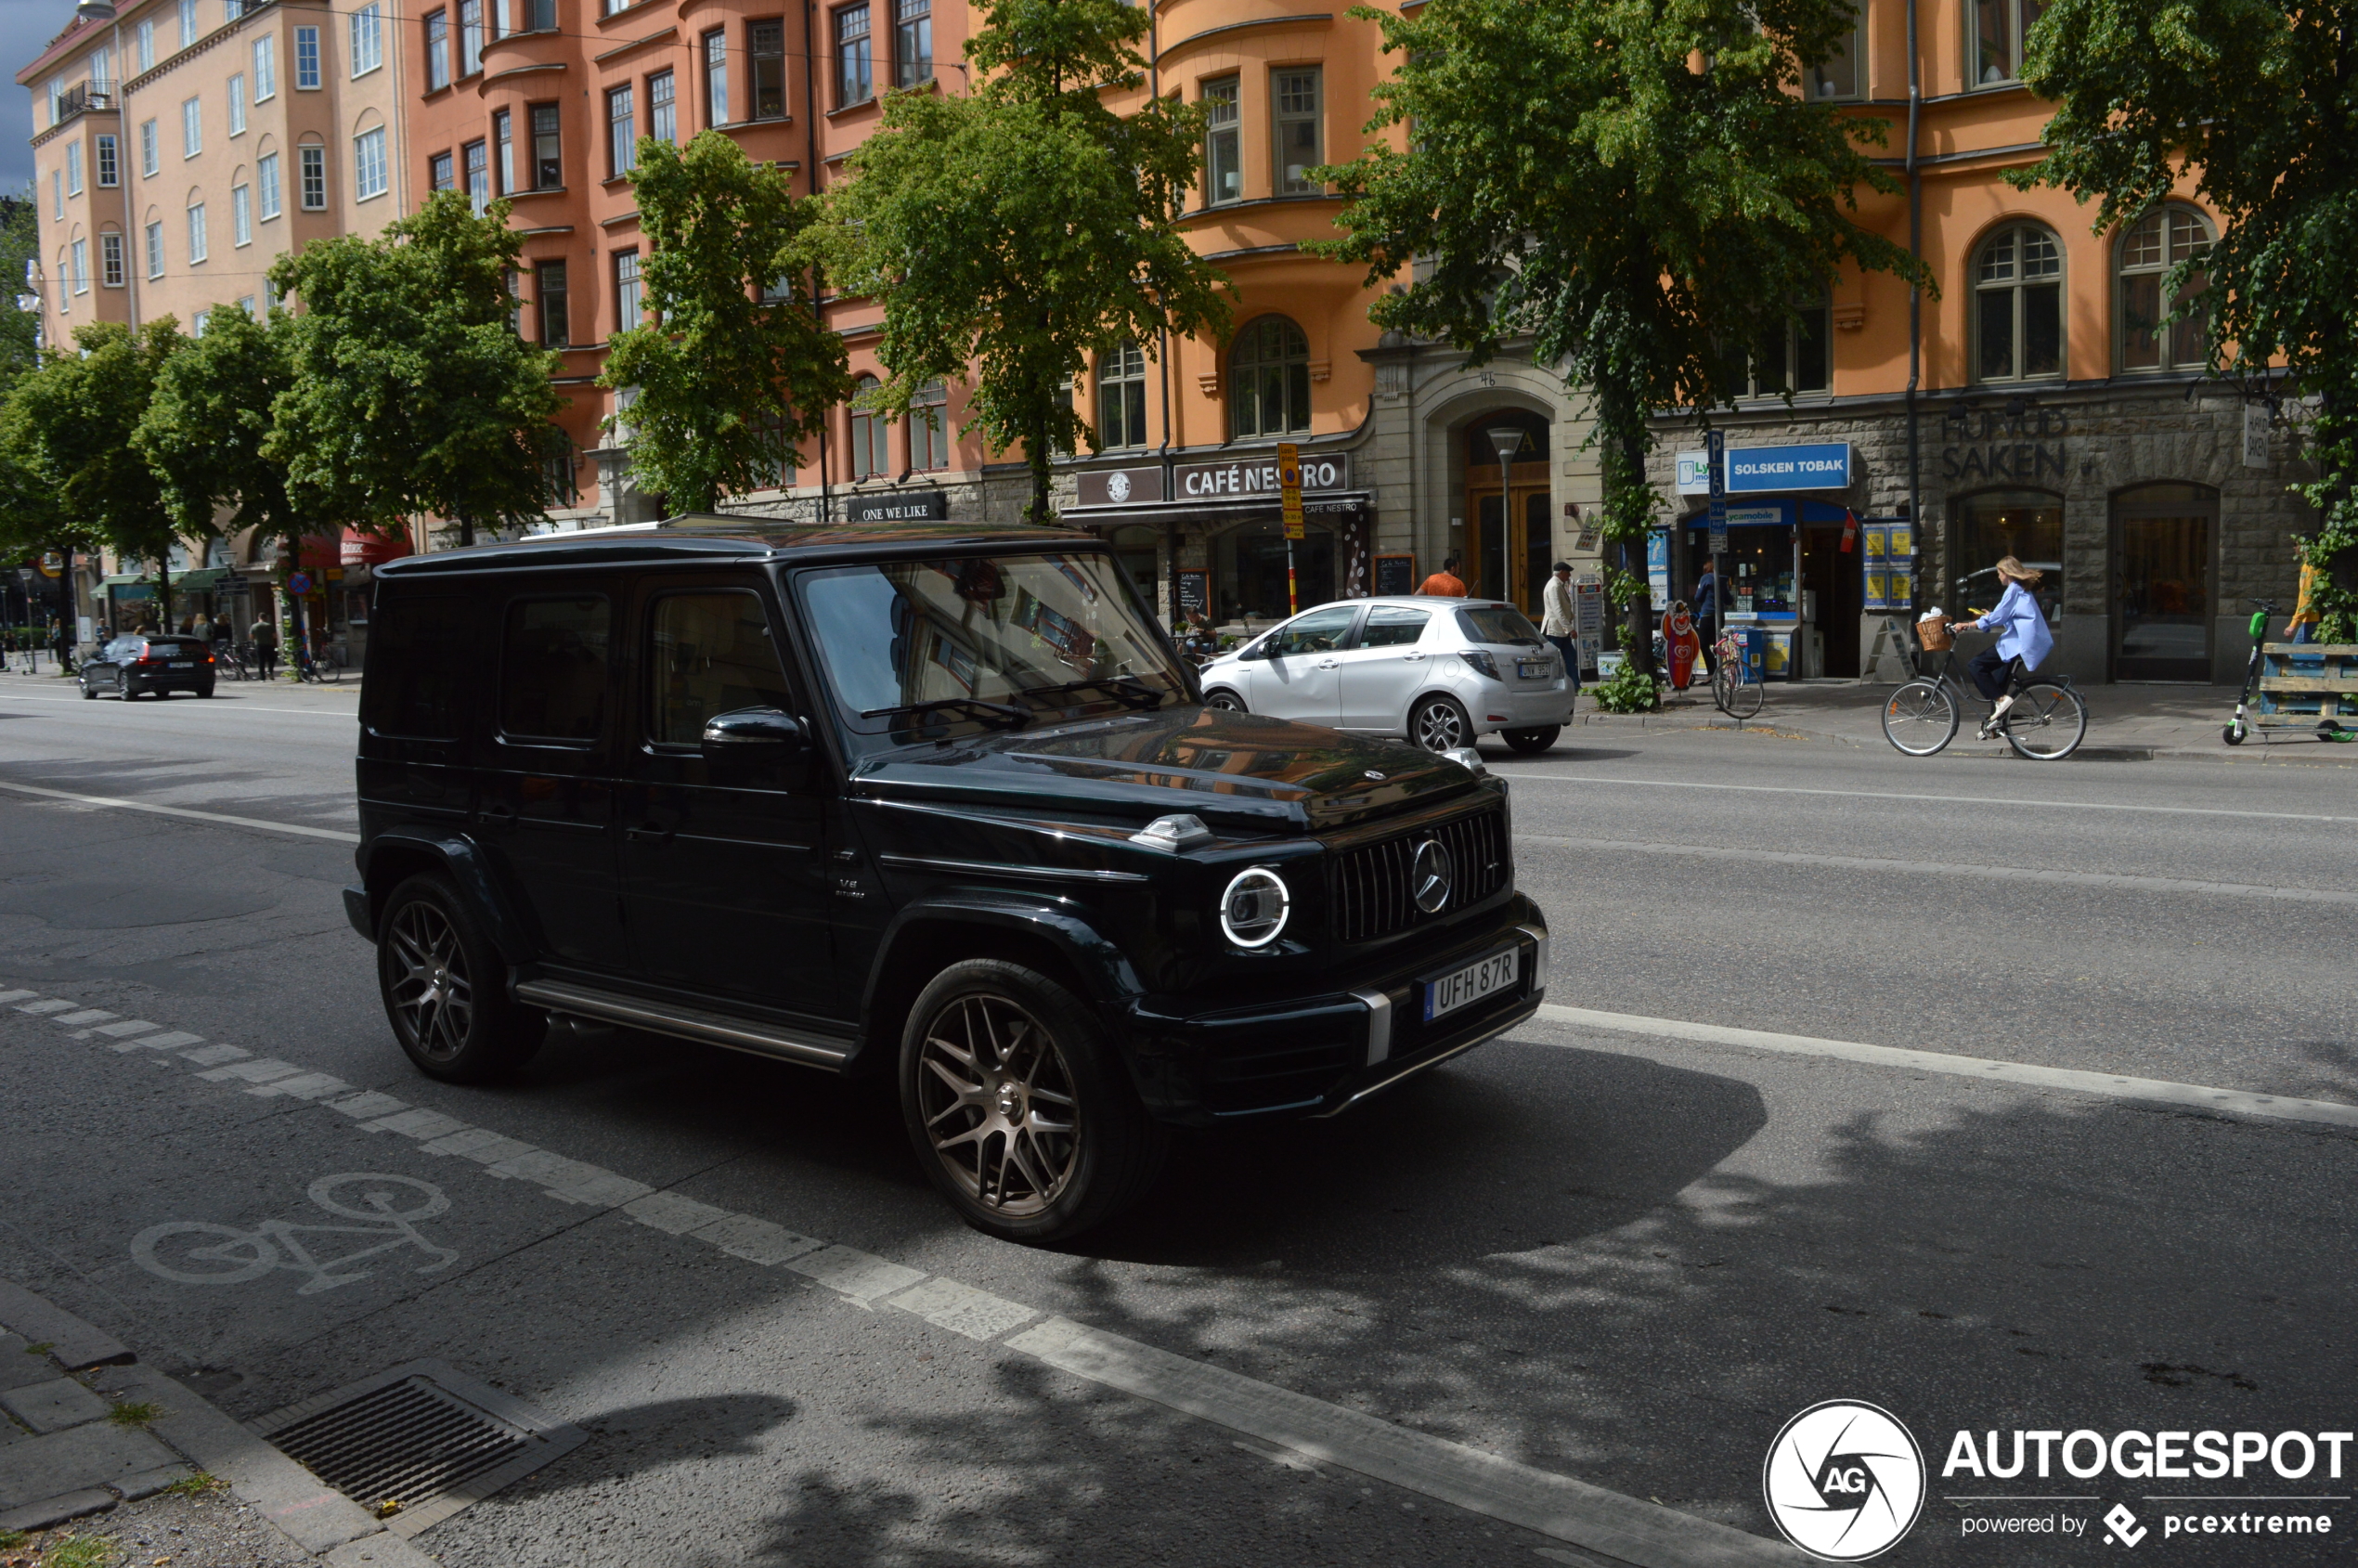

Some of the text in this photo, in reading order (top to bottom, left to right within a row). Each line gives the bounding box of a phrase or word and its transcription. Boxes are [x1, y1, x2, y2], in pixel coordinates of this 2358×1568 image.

[1520, 432, 1536, 452] A
[1734, 460, 1845, 475] SOLSKEN TOBAK
[1942, 443, 2066, 480] SAKEN
[1185, 462, 1336, 495] CAFÉ NERO
[862, 504, 928, 521] ONE WE LIKE
[1304, 502, 1357, 514] CAFÉ NESTRO
[1538, 665, 1549, 675] 952
[1440, 953, 1511, 1009] UFH 87R
